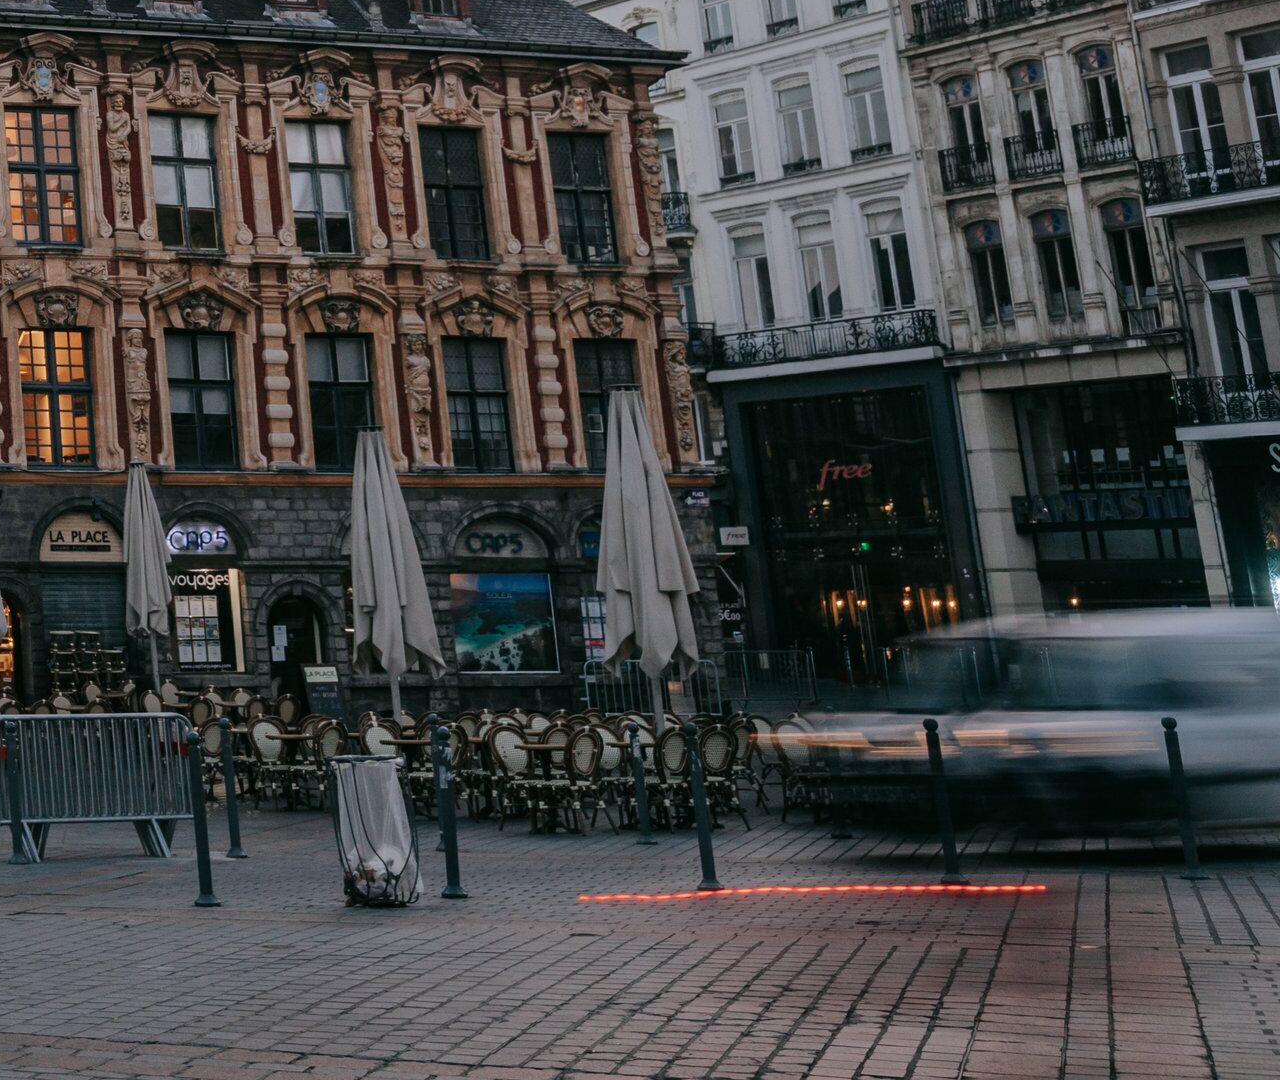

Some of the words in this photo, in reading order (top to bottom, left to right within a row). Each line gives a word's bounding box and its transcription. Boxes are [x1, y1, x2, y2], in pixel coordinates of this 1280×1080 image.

[816, 459, 873, 492] free
[49, 530, 65, 542] LA
[71, 530, 111, 543] PLACE
[726, 531, 746, 541] free
[168, 573, 231, 590] voyages
